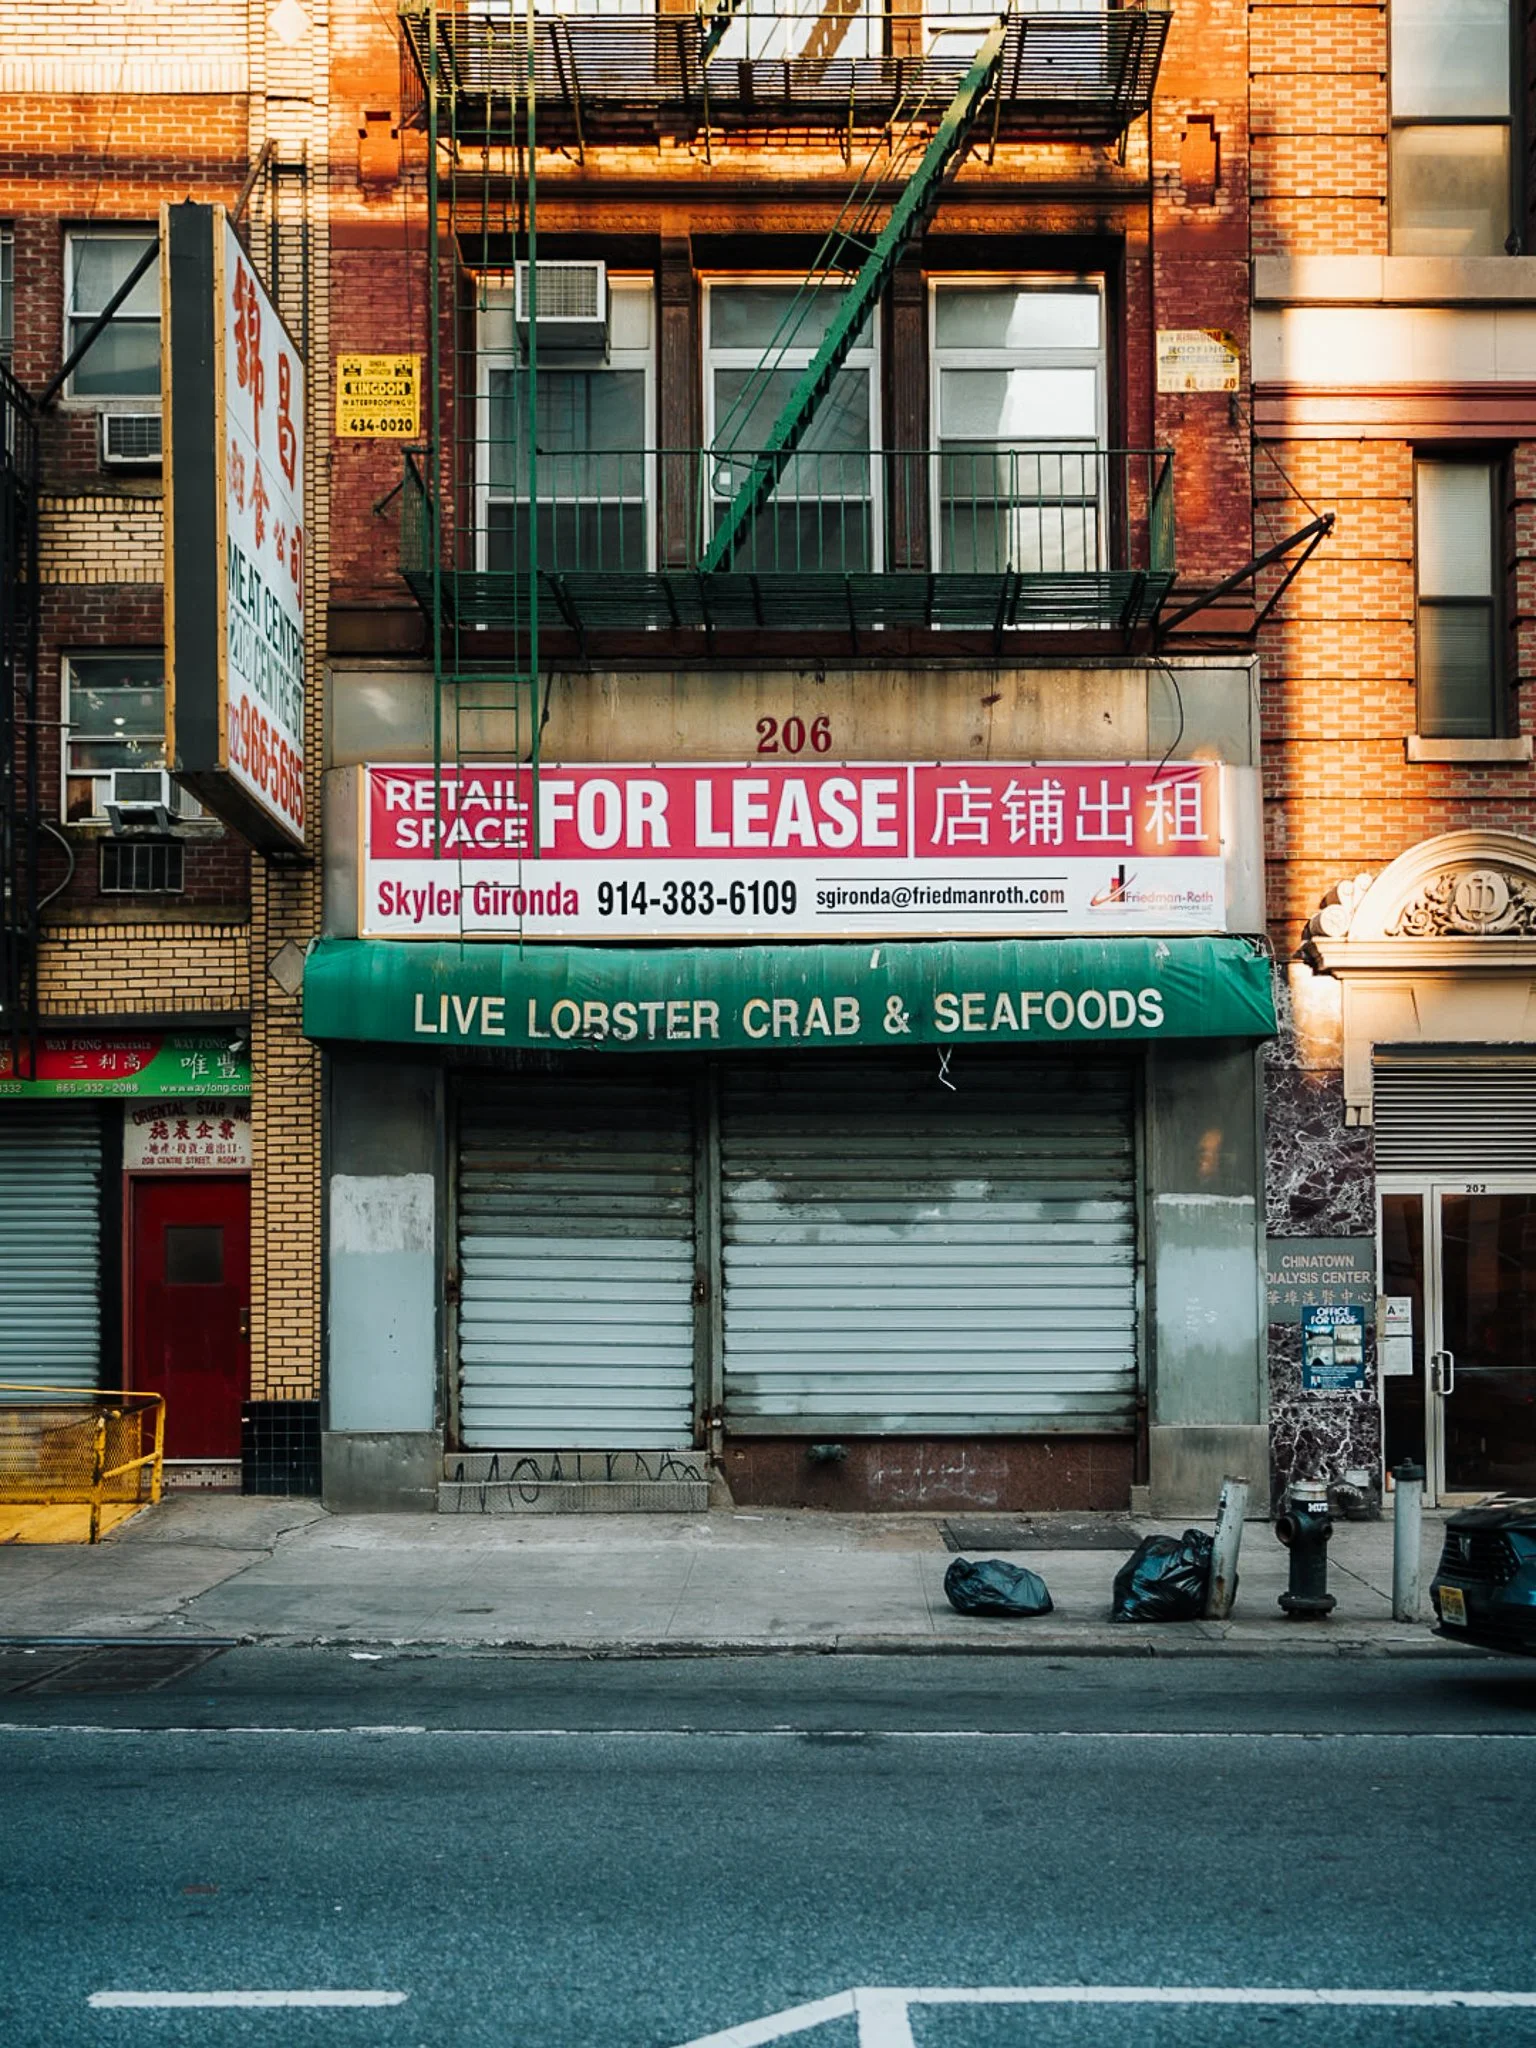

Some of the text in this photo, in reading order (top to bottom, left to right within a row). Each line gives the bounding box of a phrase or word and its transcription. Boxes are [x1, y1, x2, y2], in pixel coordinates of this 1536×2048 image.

[233, 256, 291, 492] 錦昌
[350, 382, 406, 395] KINGDOM
[350, 418, 413, 432] 434-0020
[228, 534, 304, 689] MEAT CENTRE
[757, 716, 832, 754] 206
[240, 693, 304, 829] 966-5665
[386, 780, 529, 812] RETAIL
[539, 778, 899, 850] FOR LEASE
[931, 779, 1209, 847] 店铺出租
[395, 818, 527, 849] SPACE
[378, 880, 1065, 923] Skyler Gironda 914-383-6109 sgironda@friedmanroth.com
[414, 988, 1164, 1040] LIVE LOBSTER CRAB & SEAFOODS
[45, 1040, 67, 1050] WAY
[72, 1040, 101, 1050] FONG
[174, 1039, 227, 1049] WAY FONG
[69, 1053, 141, 1070] 三利高
[132, 1101, 187, 1126] ORIENTAL
[196, 1100, 225, 1117] STAR
[1466, 1184, 1486, 1192] 202
[1281, 1255, 1355, 1268] CHINATOWN
[1266, 1271, 1371, 1284] DIALYSIS CENTER
[1310, 1316, 1330, 1325] FOR
[1316, 1307, 1350, 1316] OFFICE
